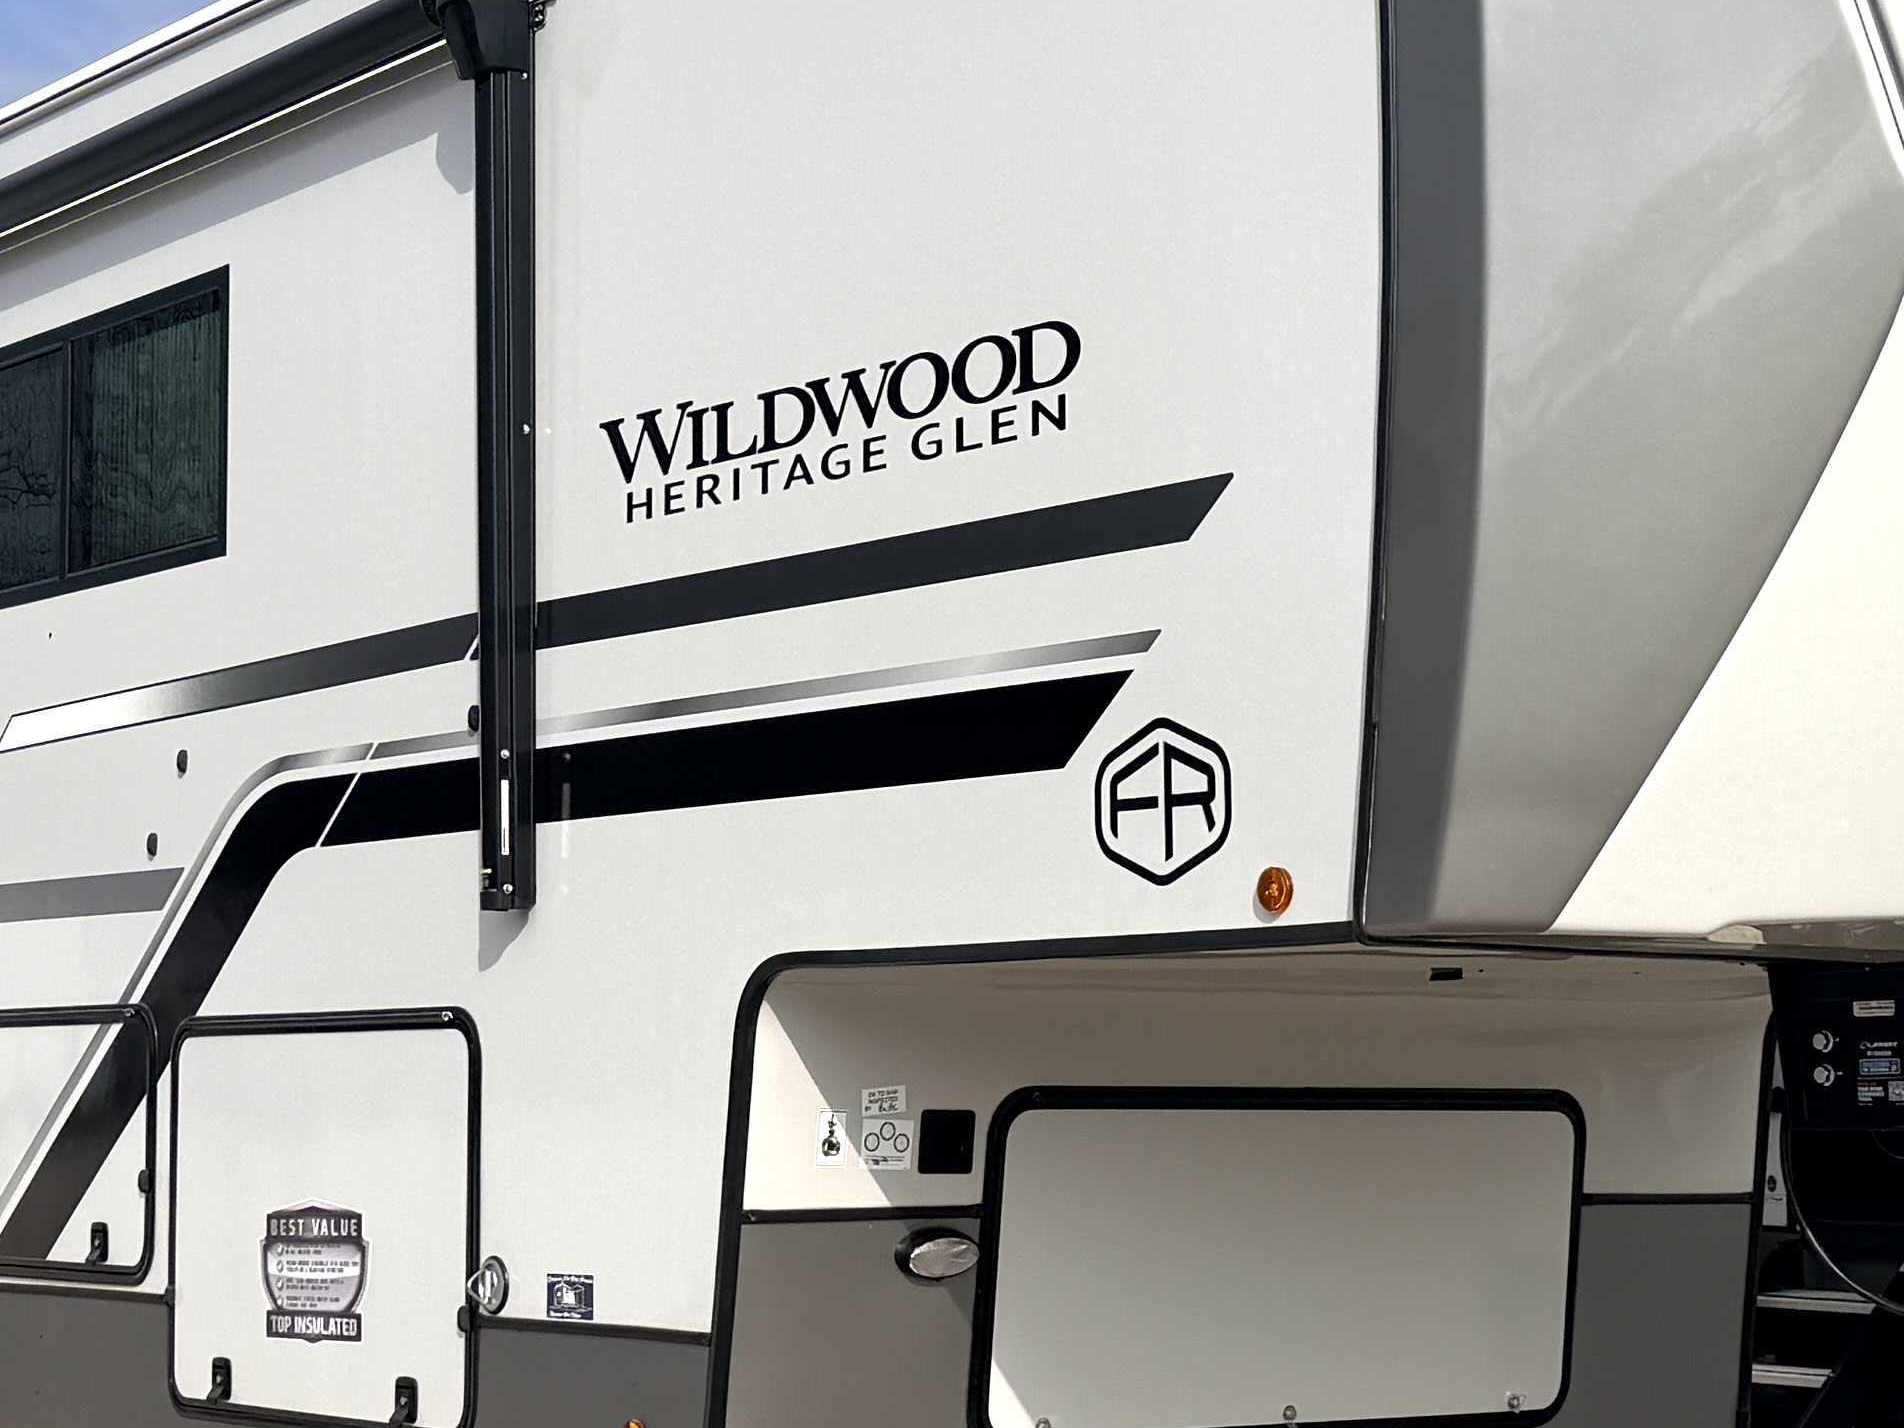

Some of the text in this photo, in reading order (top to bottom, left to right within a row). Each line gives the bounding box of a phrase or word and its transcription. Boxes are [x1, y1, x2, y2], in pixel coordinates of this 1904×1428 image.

[599, 320, 1082, 484] WILDWOOD
[625, 393, 1068, 524] HERITAGE GLEN
[270, 1218, 358, 1237] BEST VALUE
[270, 1315, 358, 1337] TOP INSULATED
